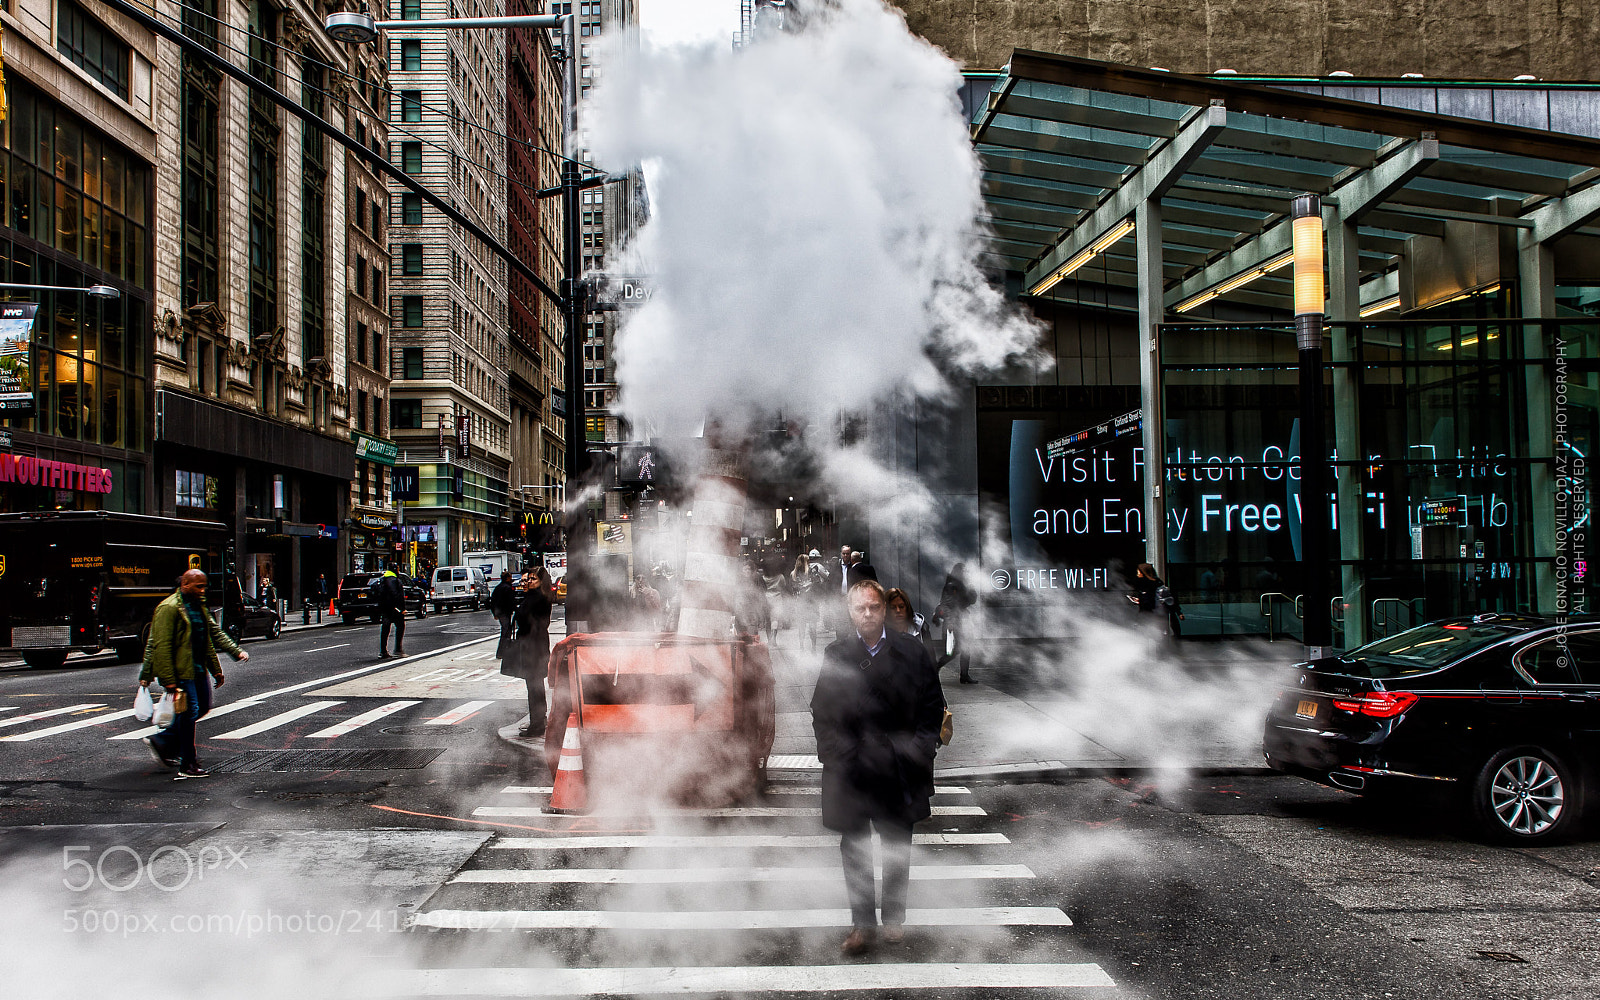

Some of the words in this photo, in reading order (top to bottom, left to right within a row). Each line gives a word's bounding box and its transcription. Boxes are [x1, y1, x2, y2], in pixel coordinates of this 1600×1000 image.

[4, 309, 23, 317] NYC
[1035, 448, 1116, 482] Visit
[1133, 447, 1245, 481] Flton
[1263, 446, 1383, 480] Cetr
[18, 456, 113, 494] OUTFITTERS
[391, 476, 412, 492] GAP
[1033, 499, 1089, 534] and
[1103, 499, 1188, 541] Eny
[1201, 494, 1281, 531] Free
[1293, 492, 1386, 530] ii
[113, 566, 134, 574] Worldwide
[546, 559, 567, 568] FedE
[1017, 569, 1057, 589] FREE
[1065, 568, 1108, 588] WI-FI
